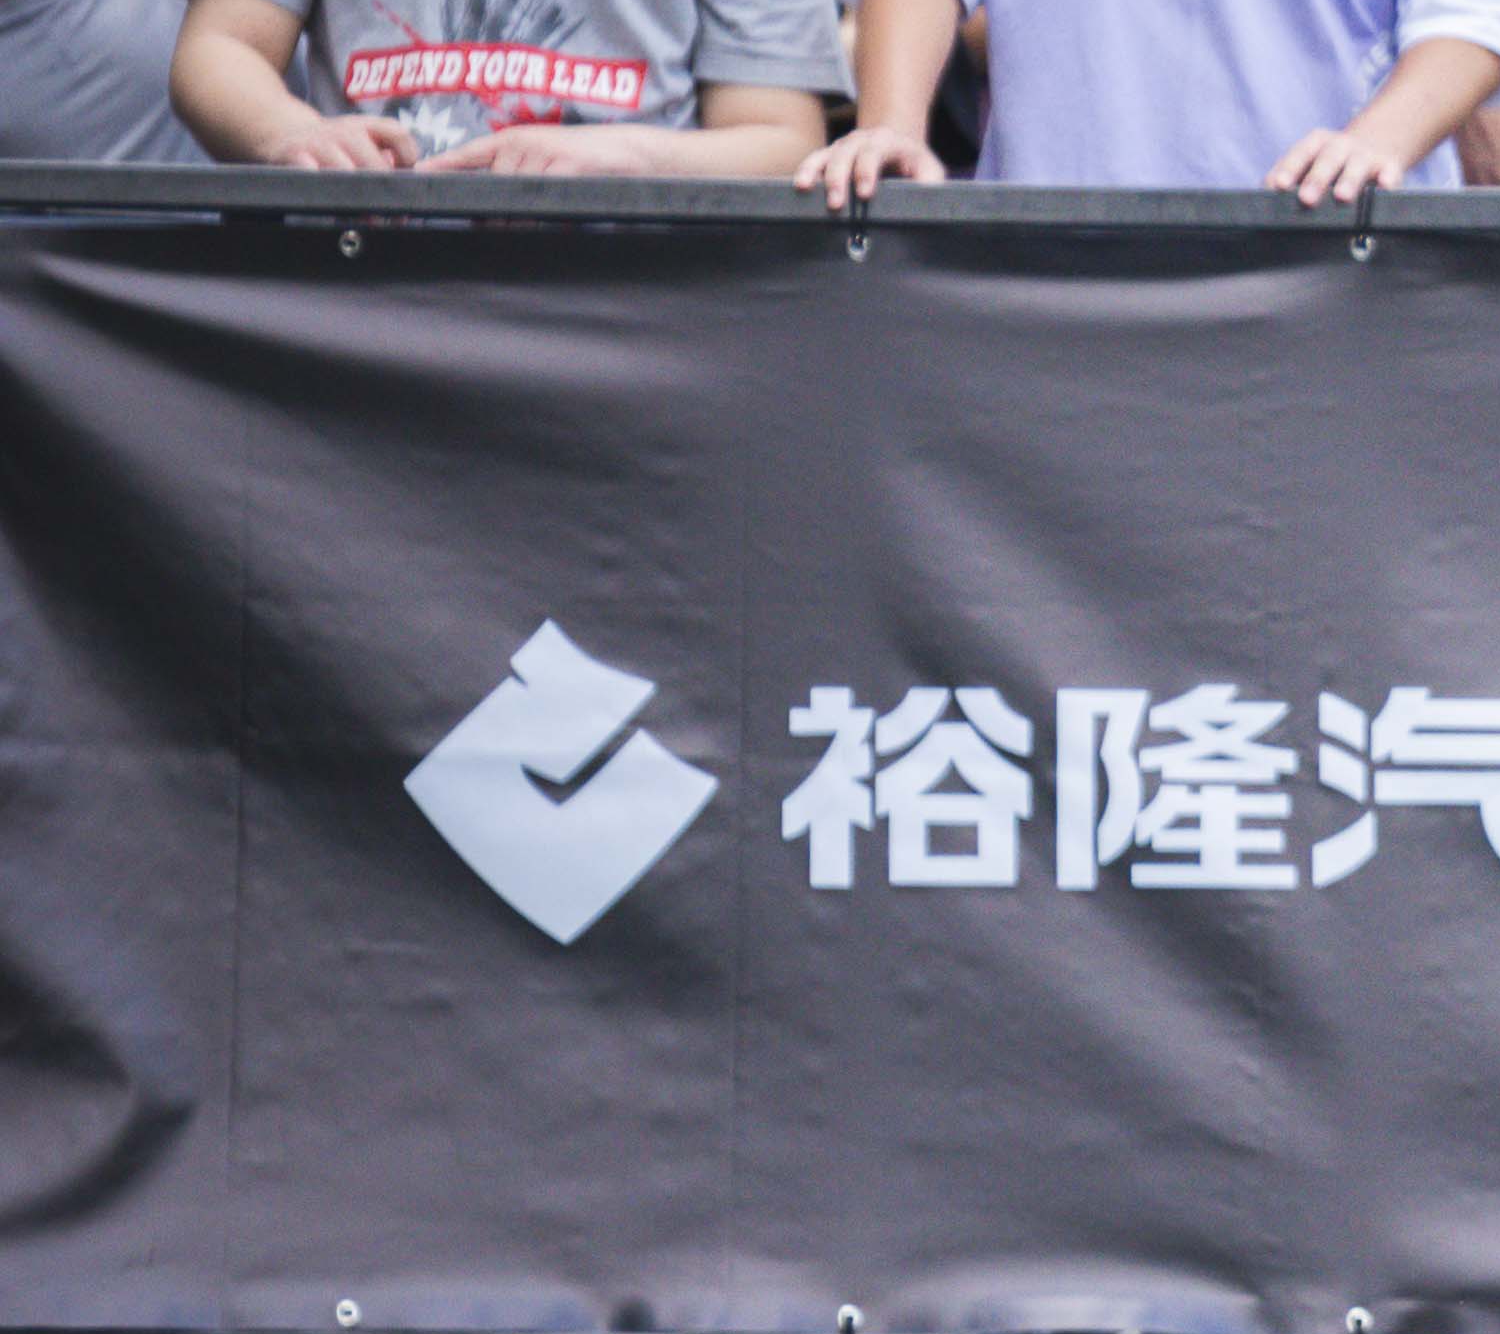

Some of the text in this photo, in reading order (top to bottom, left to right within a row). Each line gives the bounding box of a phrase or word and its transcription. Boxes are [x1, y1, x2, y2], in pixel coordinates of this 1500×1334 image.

[346, 49, 639, 101] DEFEND YOUR LEAD
